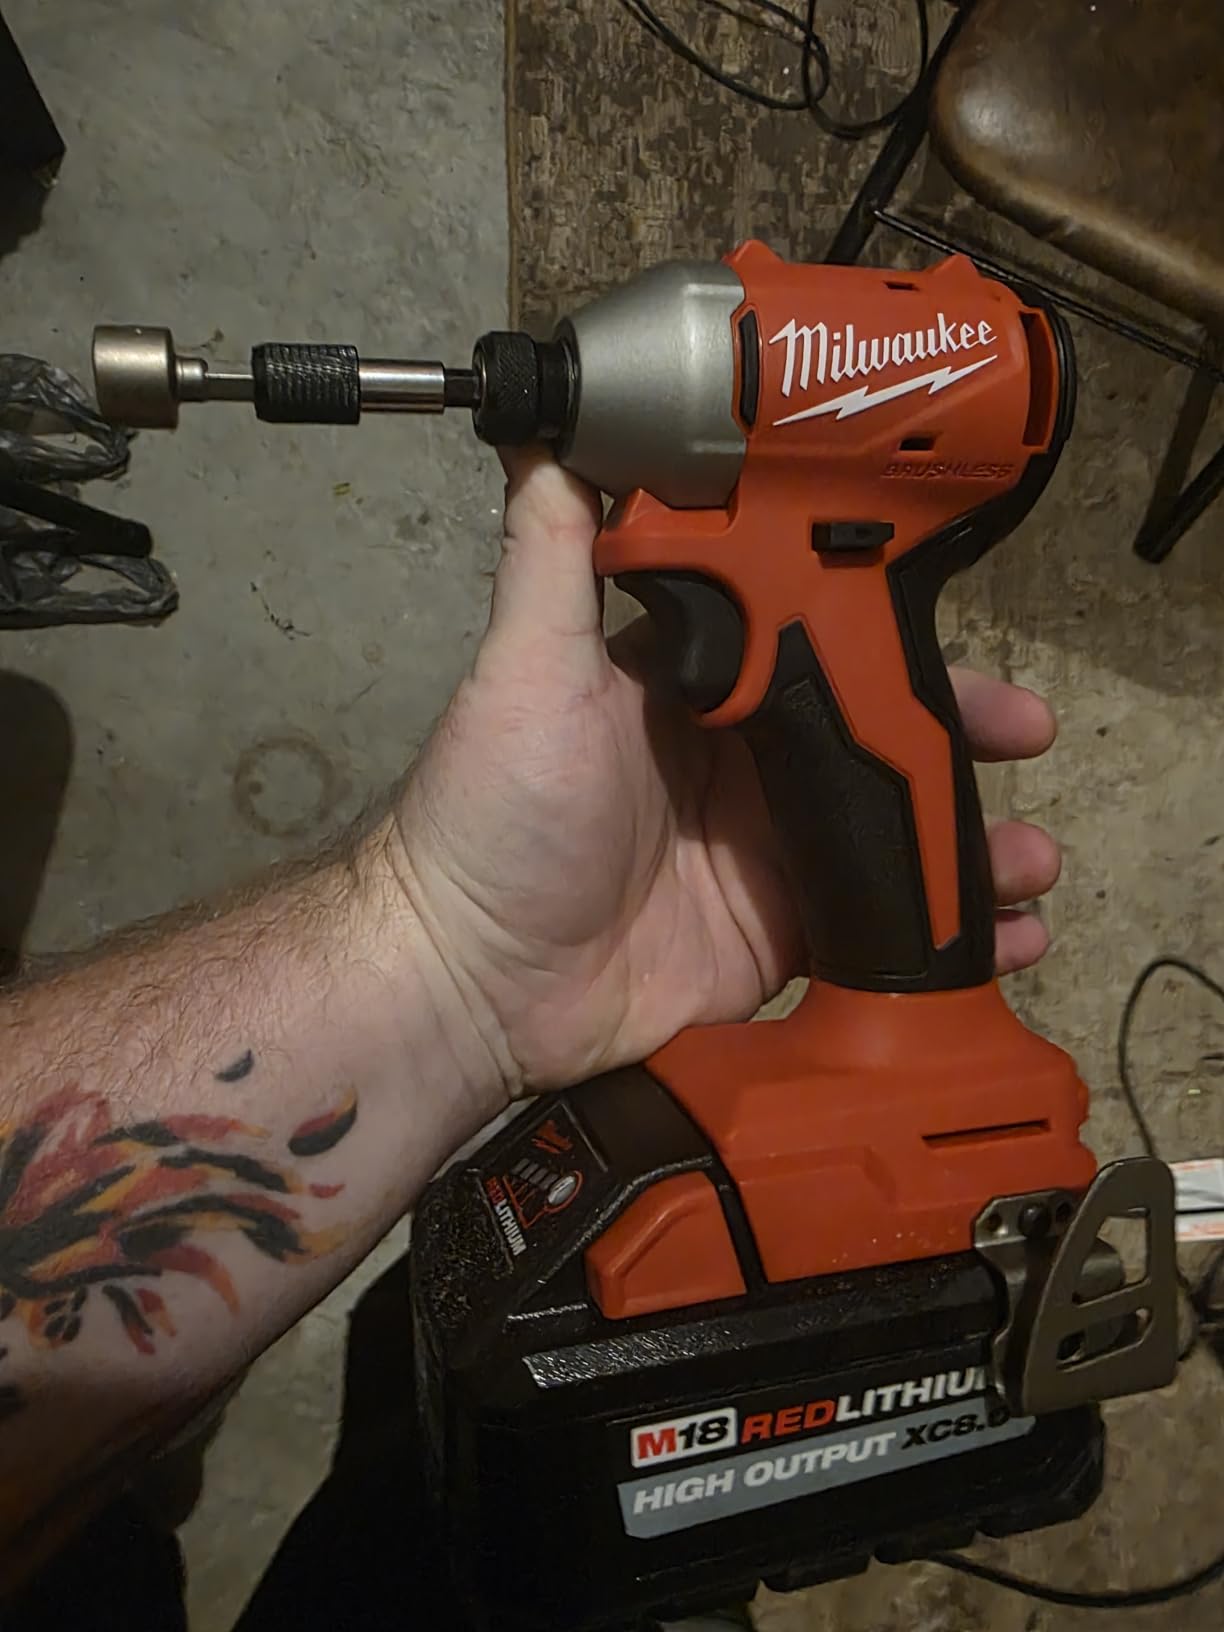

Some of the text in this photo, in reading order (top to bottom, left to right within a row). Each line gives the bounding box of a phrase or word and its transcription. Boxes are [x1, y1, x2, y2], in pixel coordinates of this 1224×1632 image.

[768, 312, 998, 397] Milwaukee
[633, 1469, 734, 1514] HIGH
[743, 1431, 897, 1487] OUTPUT
[636, 1416, 729, 1459] M18
